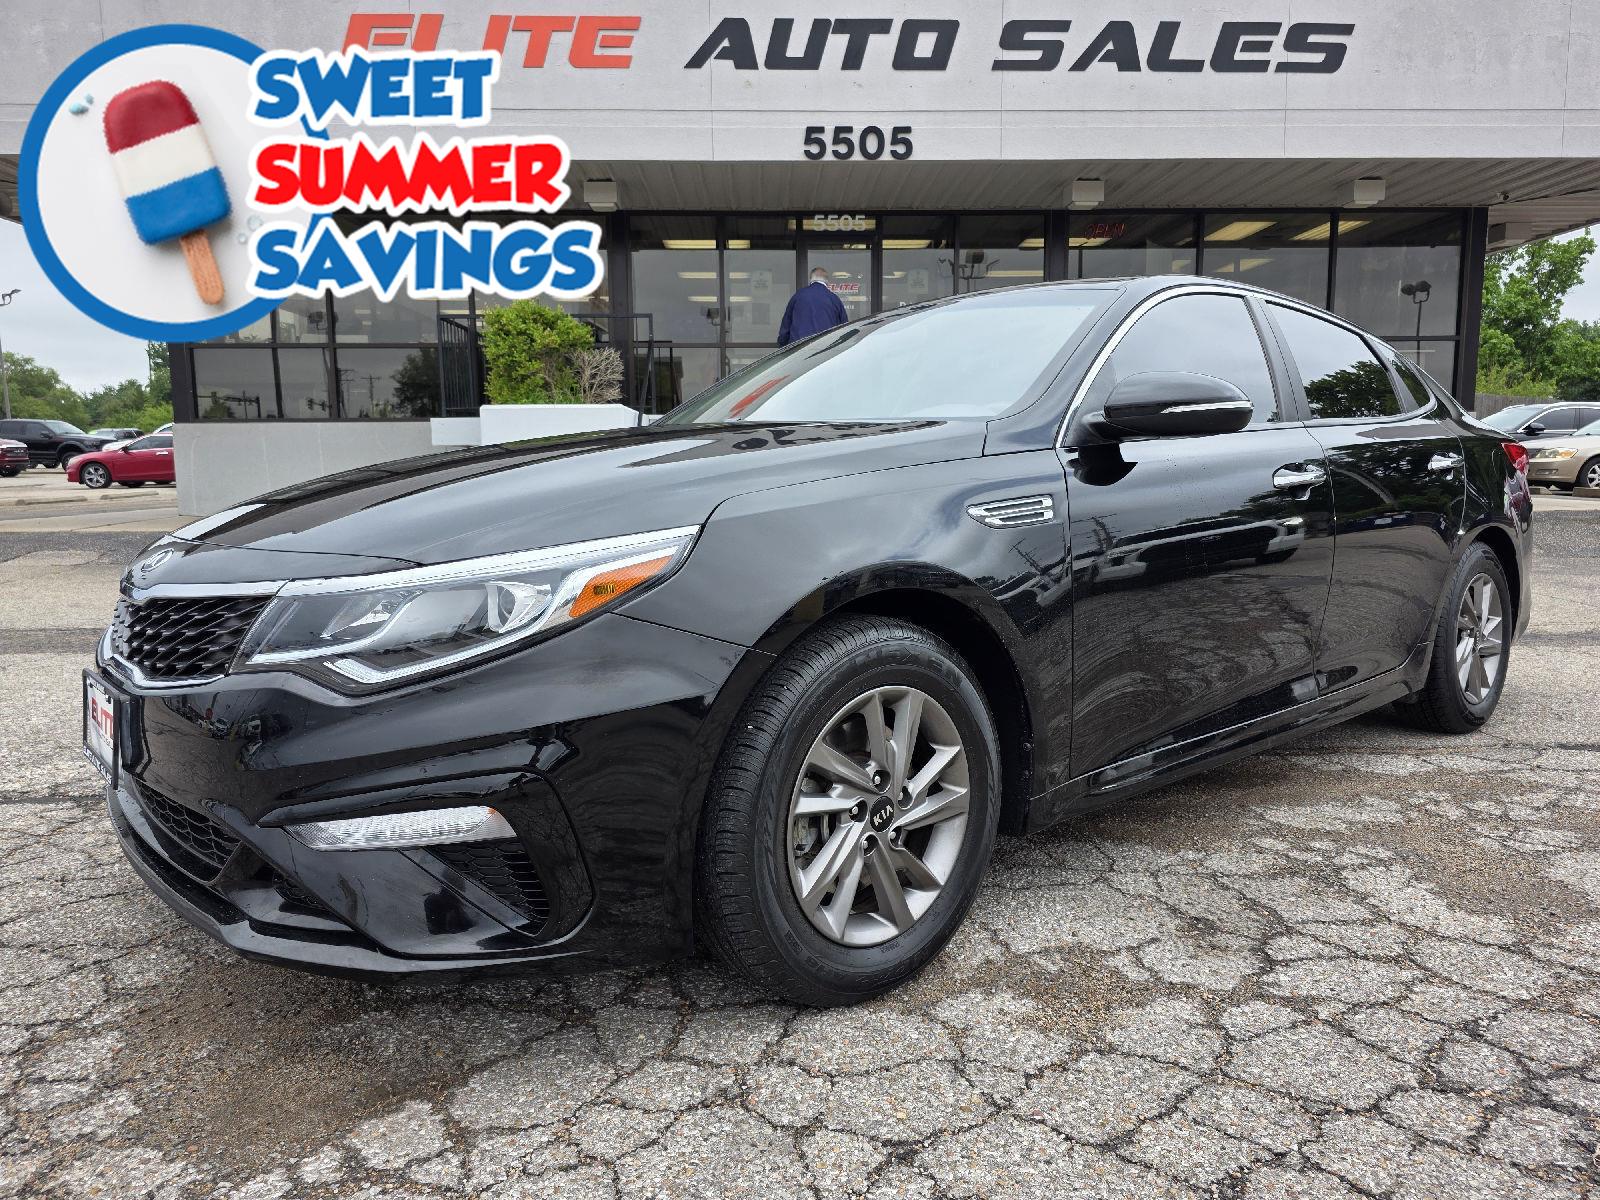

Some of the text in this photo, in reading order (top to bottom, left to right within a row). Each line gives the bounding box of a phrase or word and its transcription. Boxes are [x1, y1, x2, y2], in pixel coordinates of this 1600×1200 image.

[685, 18, 960, 71] AUTO
[992, 20, 1355, 74] SALES
[803, 125, 914, 160] 5505
[813, 214, 866, 232] 5505
[872, 804, 894, 827] KIA
